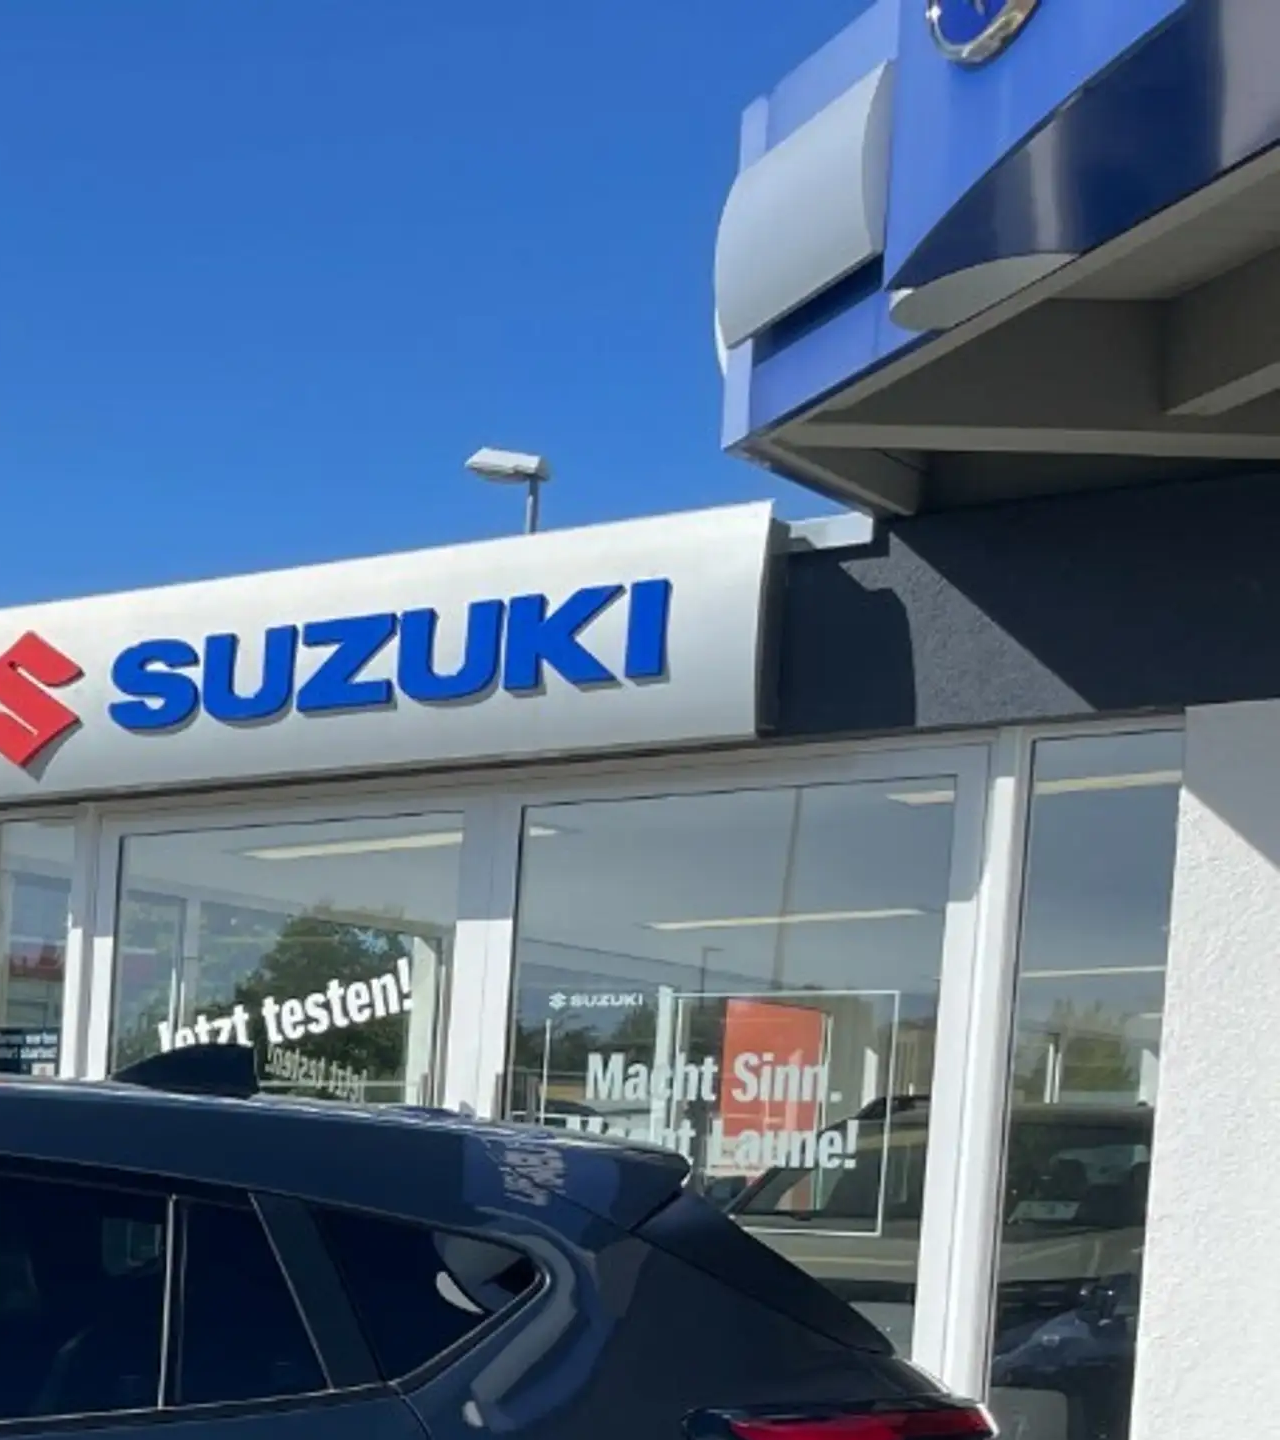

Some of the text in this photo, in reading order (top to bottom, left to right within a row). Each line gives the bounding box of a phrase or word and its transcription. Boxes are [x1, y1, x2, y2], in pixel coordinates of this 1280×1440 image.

[108, 578, 671, 734] SUZUKI
[262, 957, 414, 1044] testen!
[569, 992, 643, 1009] SUZUKI
[586, 1052, 842, 1102] Macht Sinn.
[706, 1118, 859, 1170] Laune!
